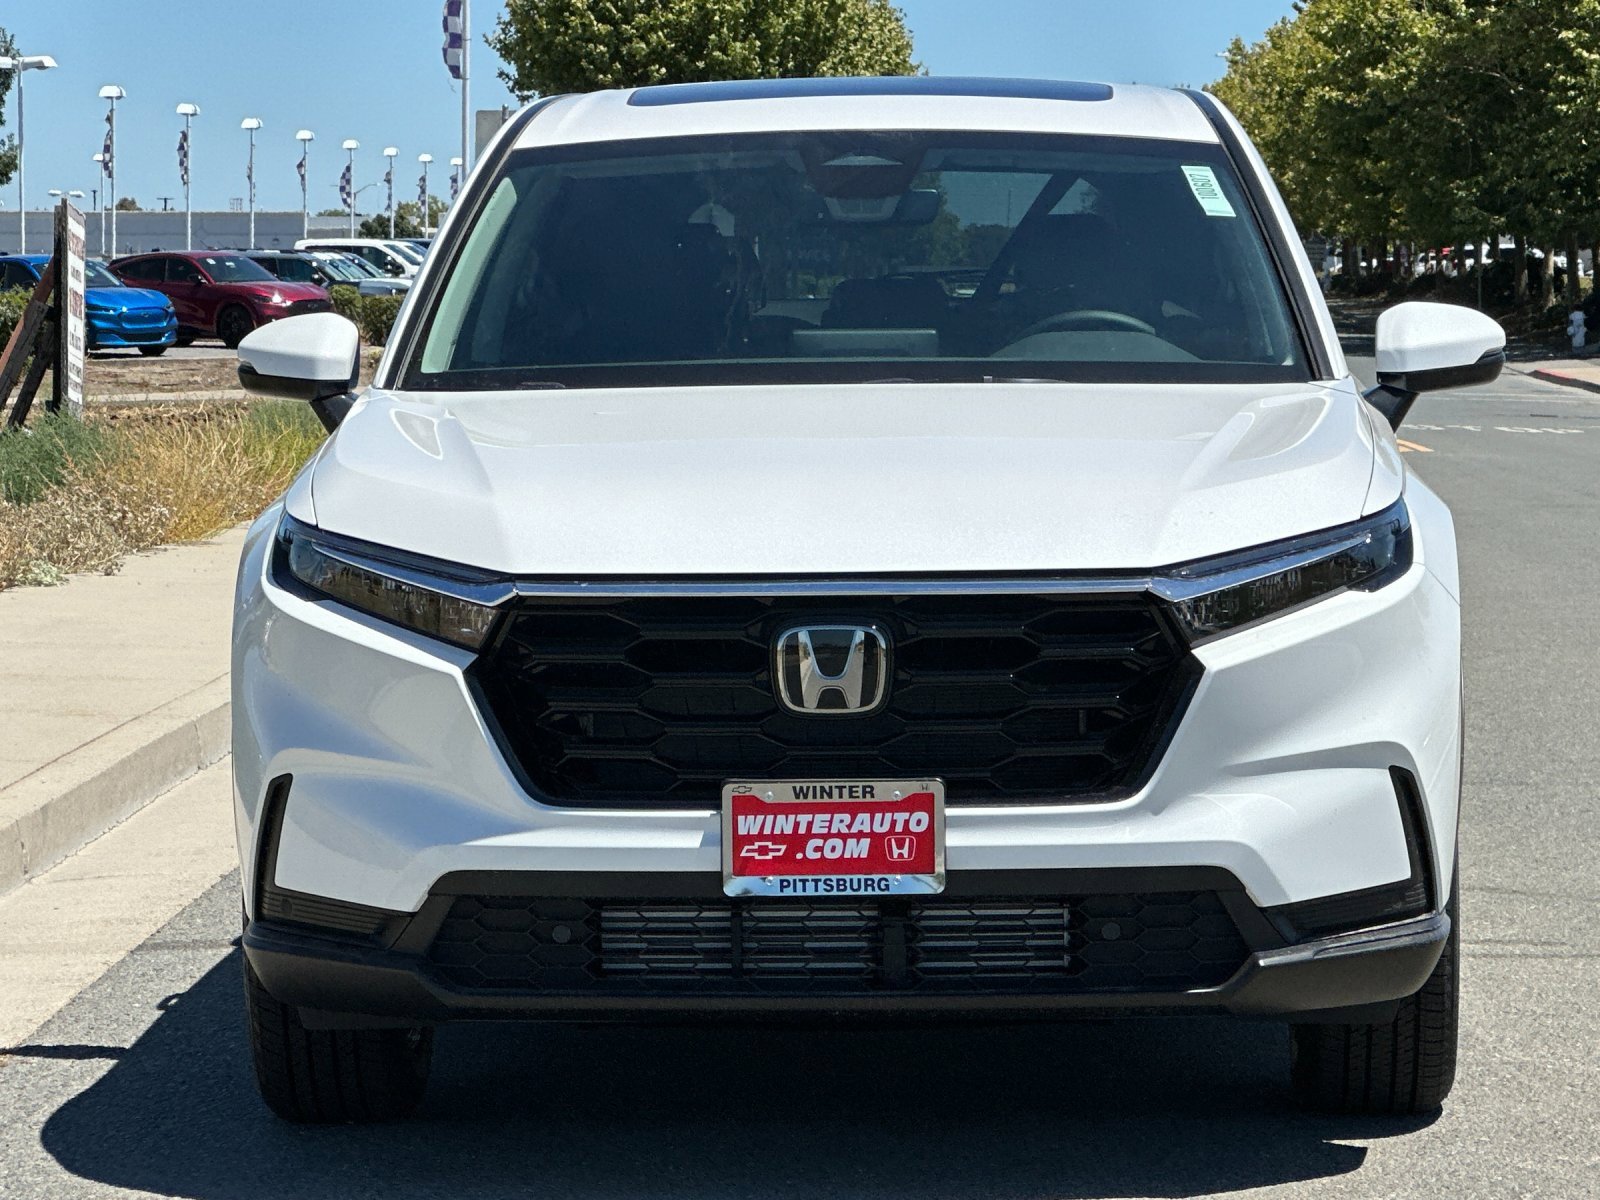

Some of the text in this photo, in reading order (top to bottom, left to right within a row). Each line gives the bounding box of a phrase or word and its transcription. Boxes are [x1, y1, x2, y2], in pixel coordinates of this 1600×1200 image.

[1189, 173, 1220, 199] 100607
[792, 785, 875, 800] WINTER
[737, 812, 929, 835] WINTERAUTO
[795, 838, 871, 859] .COM
[779, 878, 890, 893] PITTSBURG
